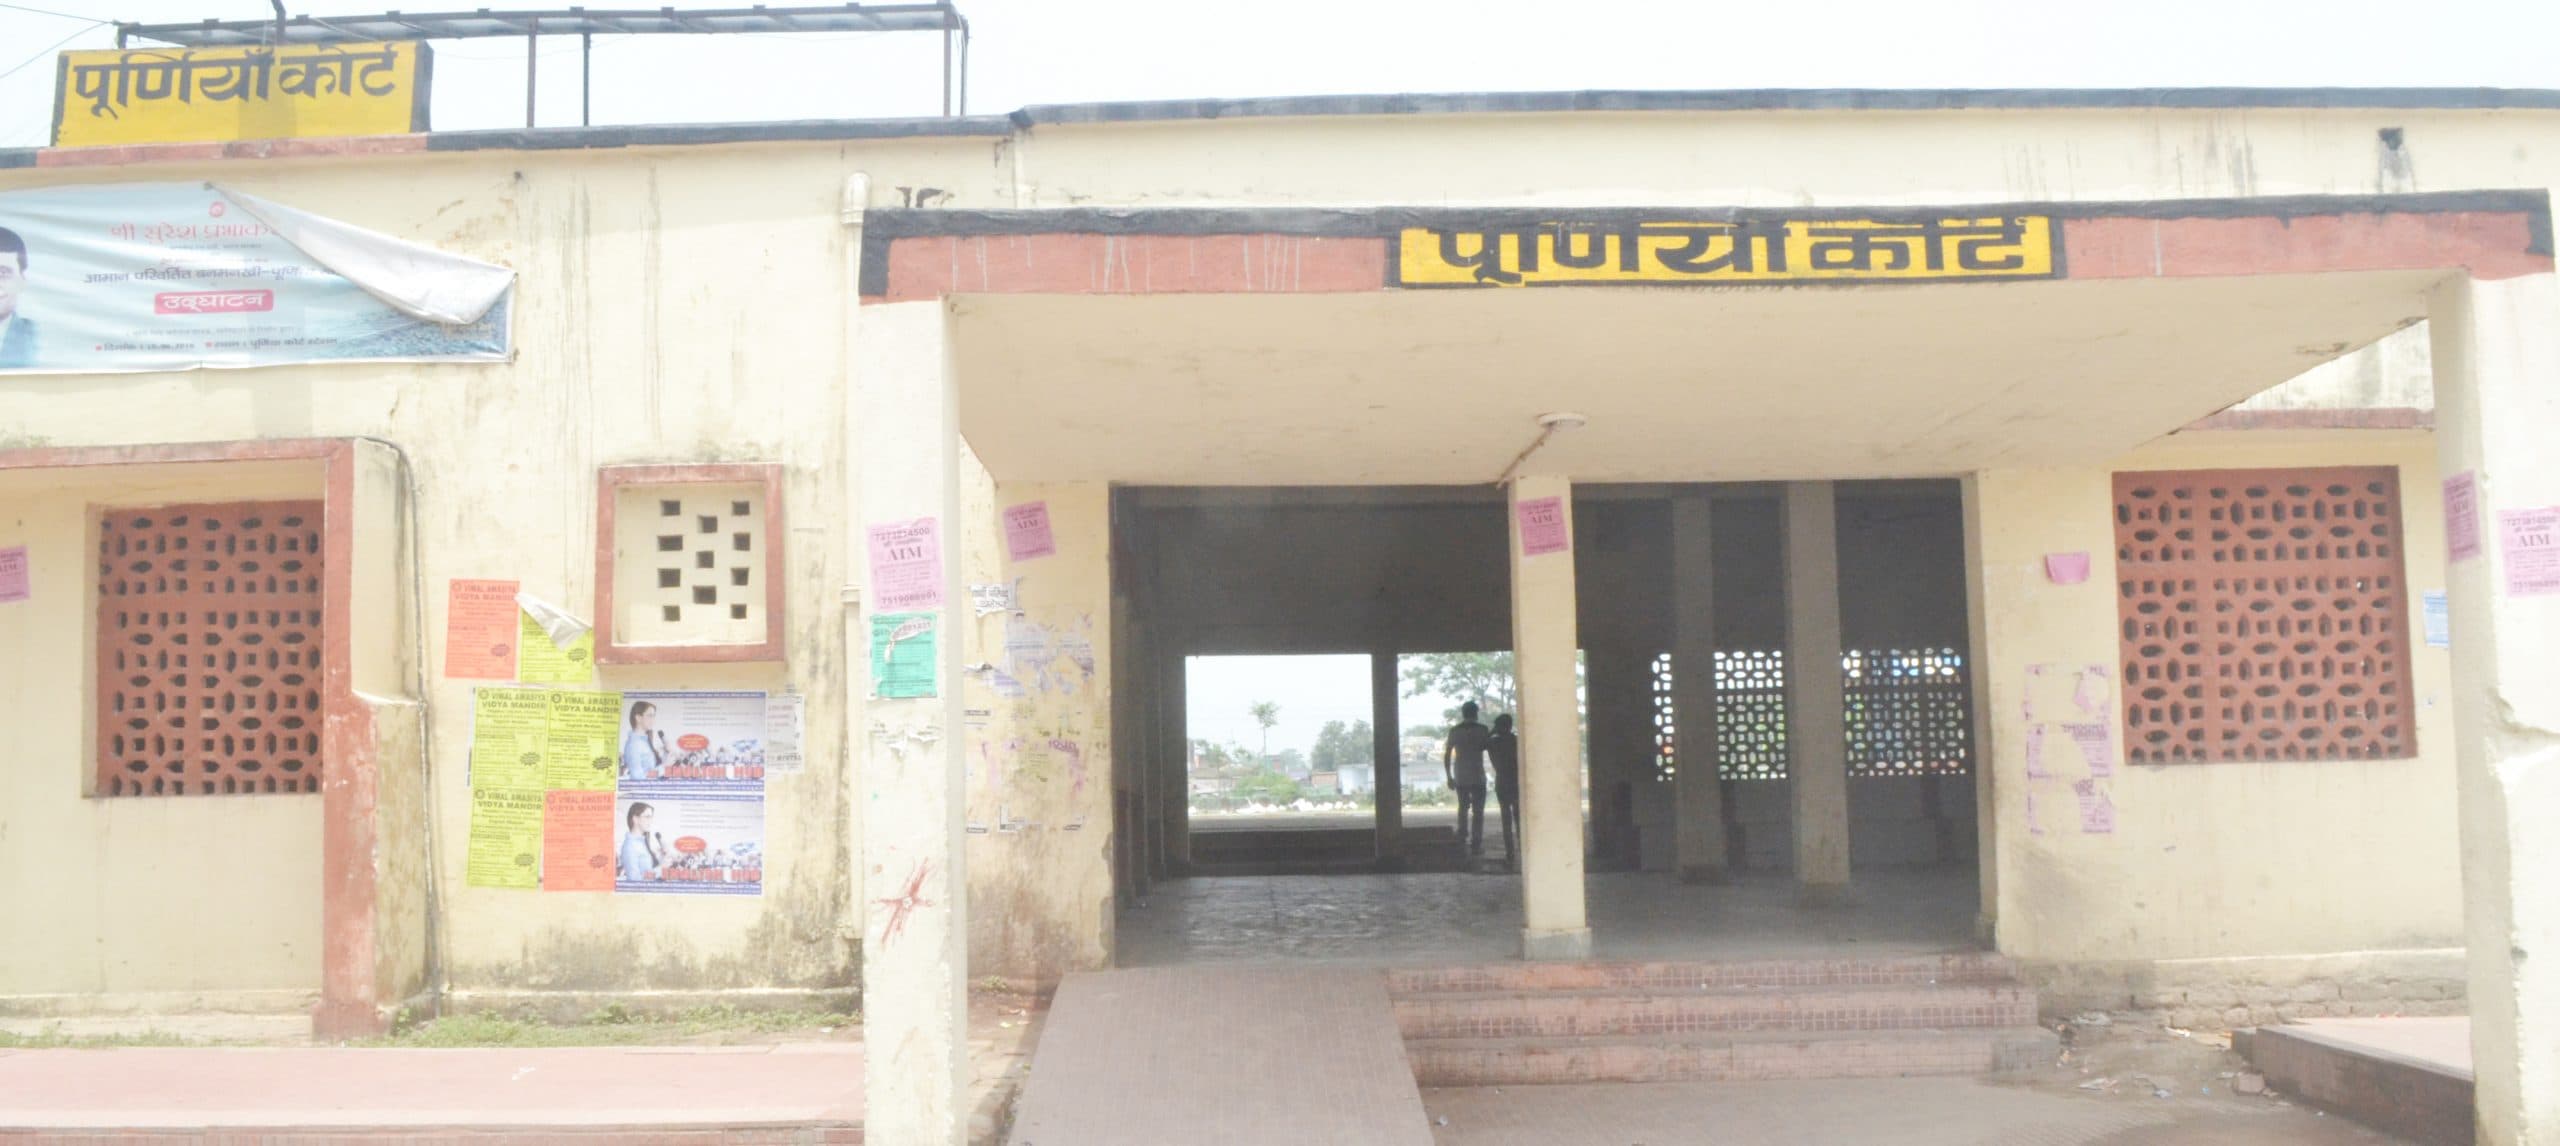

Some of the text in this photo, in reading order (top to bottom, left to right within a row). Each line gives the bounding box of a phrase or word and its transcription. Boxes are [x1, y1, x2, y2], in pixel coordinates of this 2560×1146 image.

[278, 42, 399, 98] कोर्ट
[1807, 214, 2027, 271] कोर्ट
[162, 292, 267, 313] उद्घाटन
[2518, 534, 2551, 547] AIM
[888, 546, 923, 561] AIM
[491, 692, 512, 701] VIMAL
[564, 695, 585, 705] VIMAL
[481, 701, 546, 710] VIDYA MANDIR
[555, 704, 620, 714] VIDYA MANDIR
[488, 792, 508, 801] VIMAL
[478, 801, 543, 810] VIDYA MANDIR
